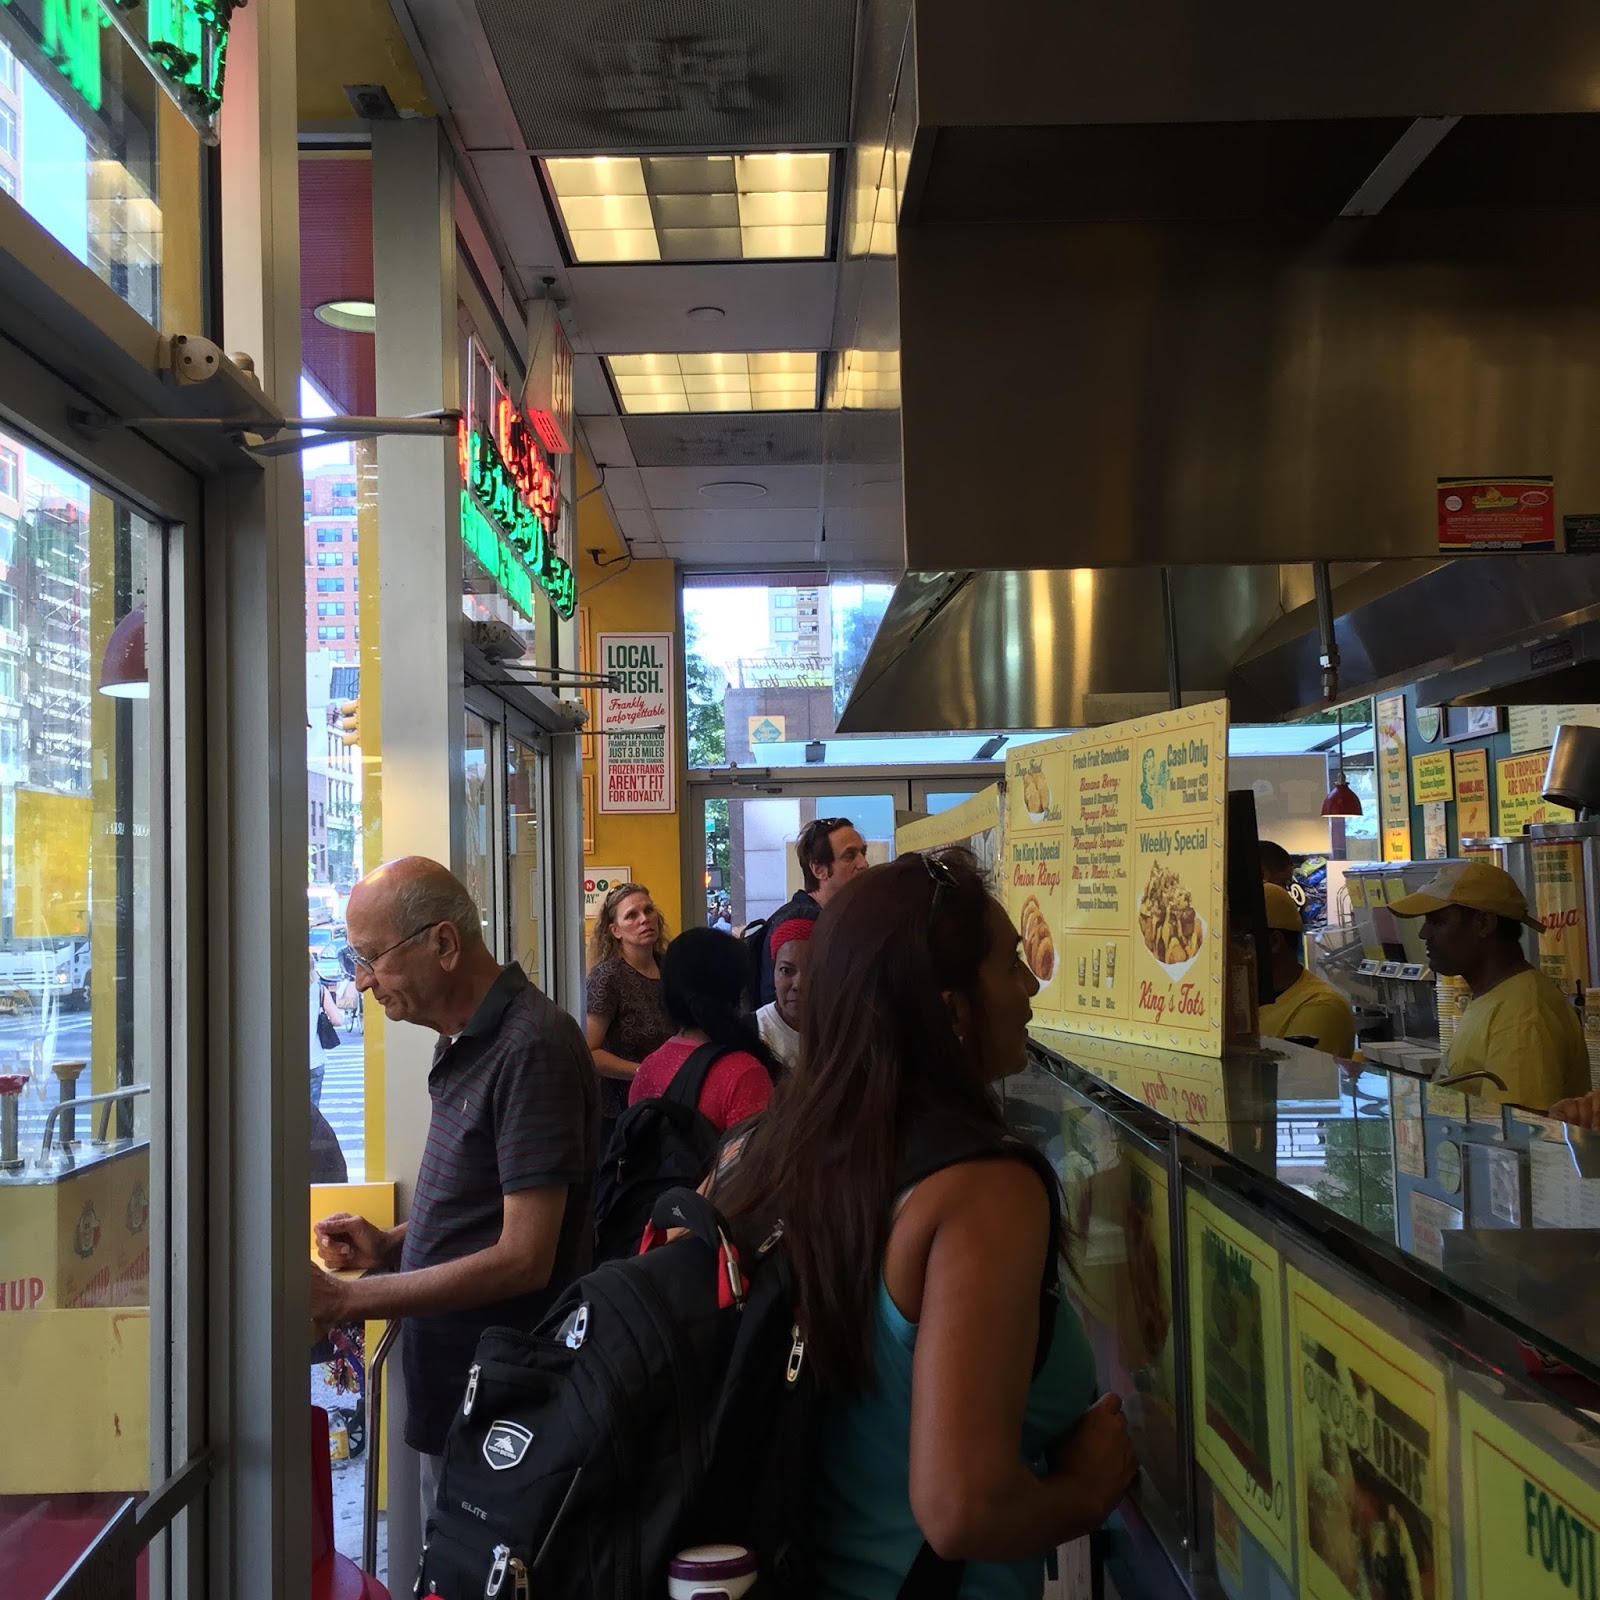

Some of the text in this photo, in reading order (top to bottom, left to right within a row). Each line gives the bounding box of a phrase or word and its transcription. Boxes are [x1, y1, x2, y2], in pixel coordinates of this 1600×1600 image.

[608, 645, 664, 669] LOCAL.
[606, 703, 666, 724] unforgettable
[608, 696, 645, 712] Frankly
[608, 747, 665, 758] JUST 3.8 MILES
[1072, 745, 1130, 771] Fresh Fruit Smoothies
[1167, 738, 1209, 768] Cash Only
[608, 764, 665, 775] FROZEN FRANKS
[608, 775, 665, 790] AREN'T FIT
[608, 790, 665, 803] FOR ROYALTY.
[1139, 827, 1208, 856] Weekly Special
[1012, 840, 1061, 866] The King's Special
[1013, 861, 1061, 896] Onion Rings
[1139, 980, 1175, 1024] King's
[1177, 982, 1206, 1018] Tots
[461, 1501, 487, 1520] ELITE
